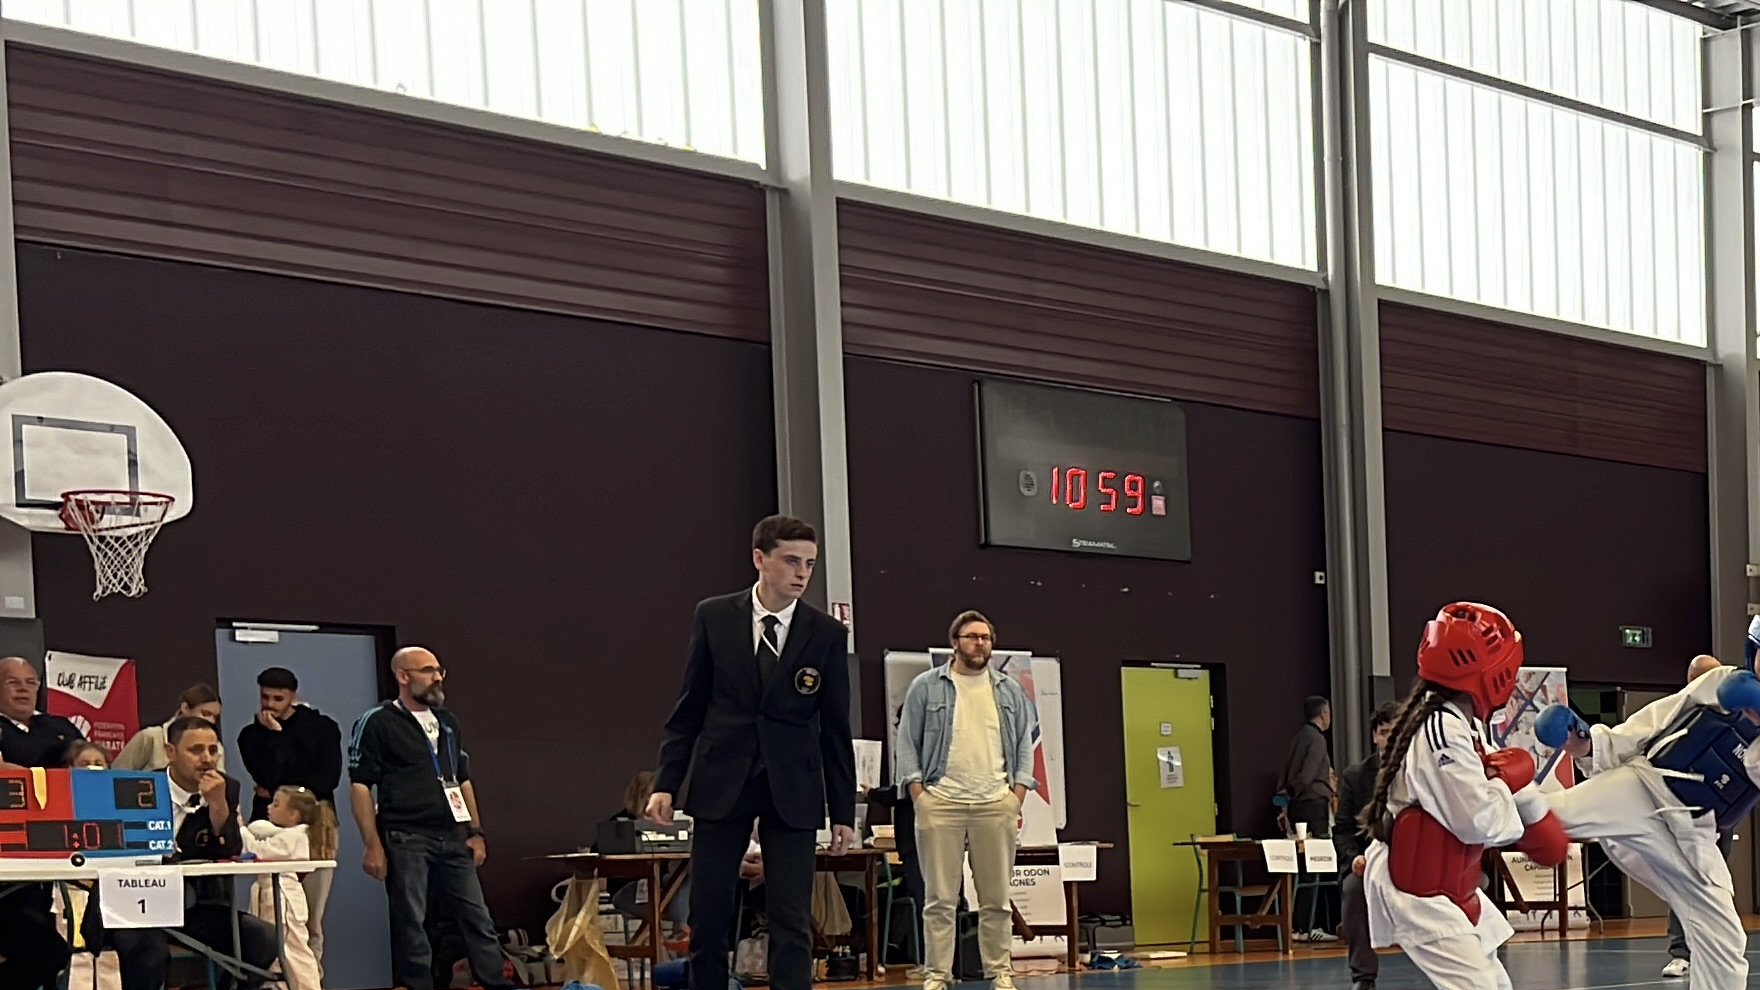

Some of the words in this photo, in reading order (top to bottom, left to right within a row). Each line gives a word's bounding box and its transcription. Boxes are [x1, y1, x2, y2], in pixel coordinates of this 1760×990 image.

[8, 779, 26, 808] 3
[137, 780, 154, 808] 2
[148, 820, 172, 831] CAT.1
[149, 840, 174, 851] CAT.2
[1023, 868, 1050, 877] ODON
[117, 878, 166, 888] TABLEAU
[137, 898, 146, 914] 1
